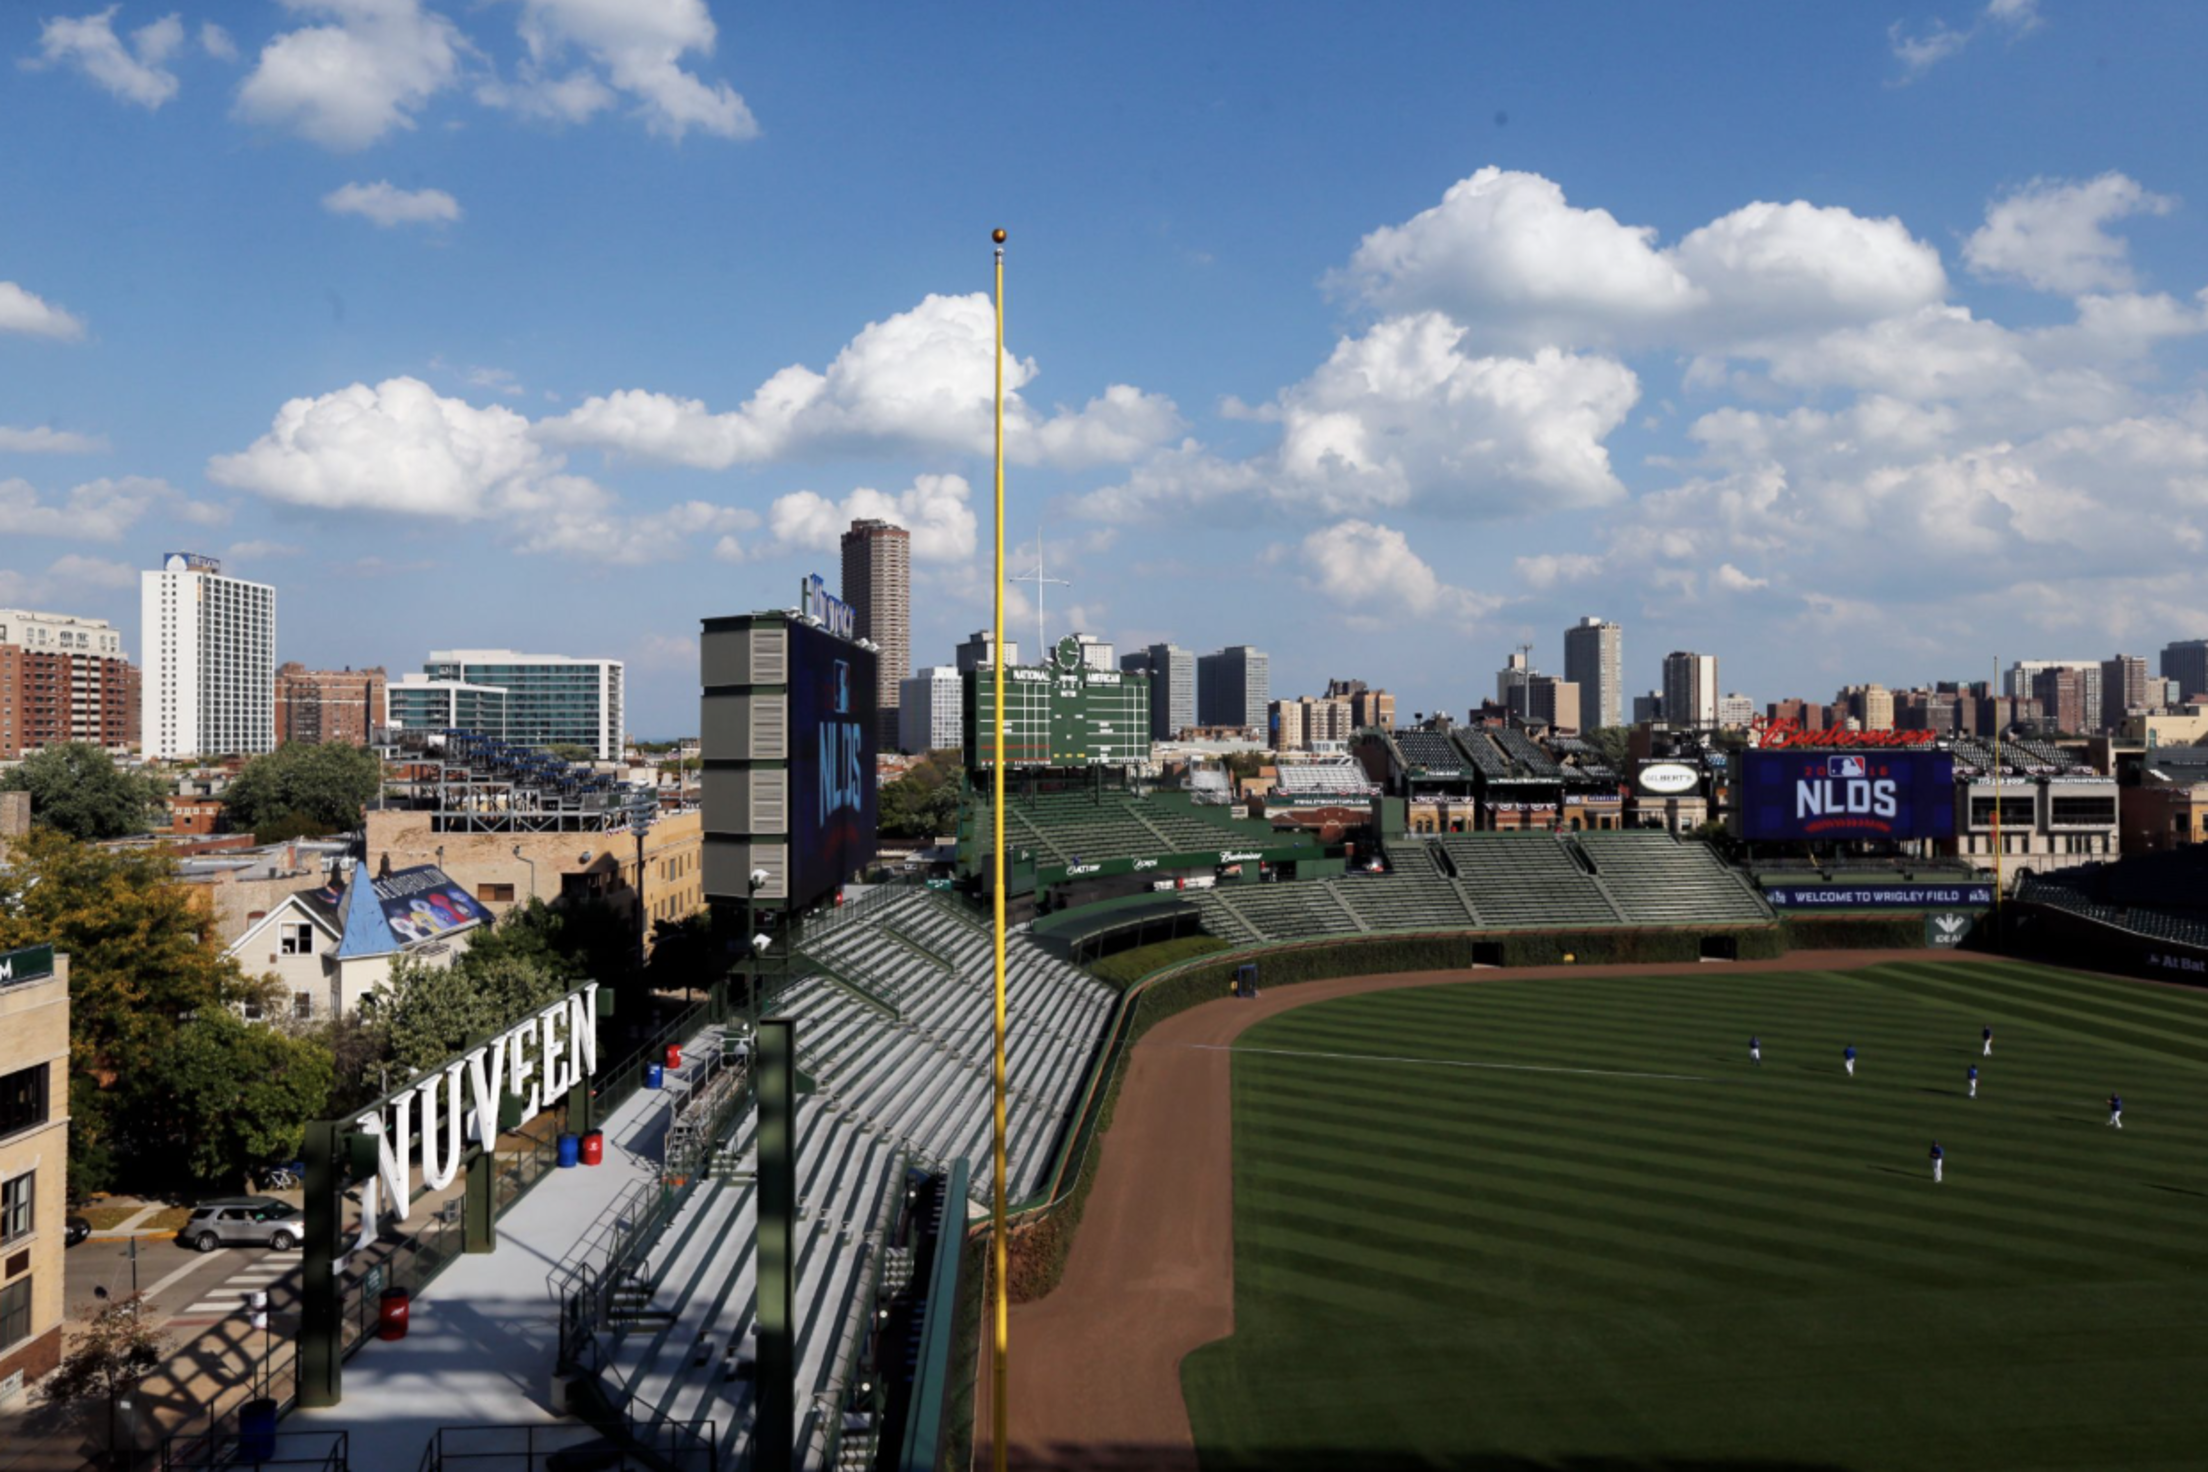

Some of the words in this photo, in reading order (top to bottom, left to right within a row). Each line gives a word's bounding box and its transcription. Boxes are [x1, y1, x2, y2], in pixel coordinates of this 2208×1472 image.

[1013, 669, 1051, 681] NATIONAL
[1753, 717, 1936, 749] Budweiser
[819, 721, 861, 828] NLDS
[1796, 779, 1896, 819] NLDS
[1219, 850, 1263, 863] Budweiser
[1795, 891, 1852, 902] WELCOME
[1855, 891, 1871, 902] TO
[1873, 890, 1925, 902] WRIGLEY
[1926, 890, 1960, 902] FIELD
[345, 983, 599, 1250] NUVEEN
